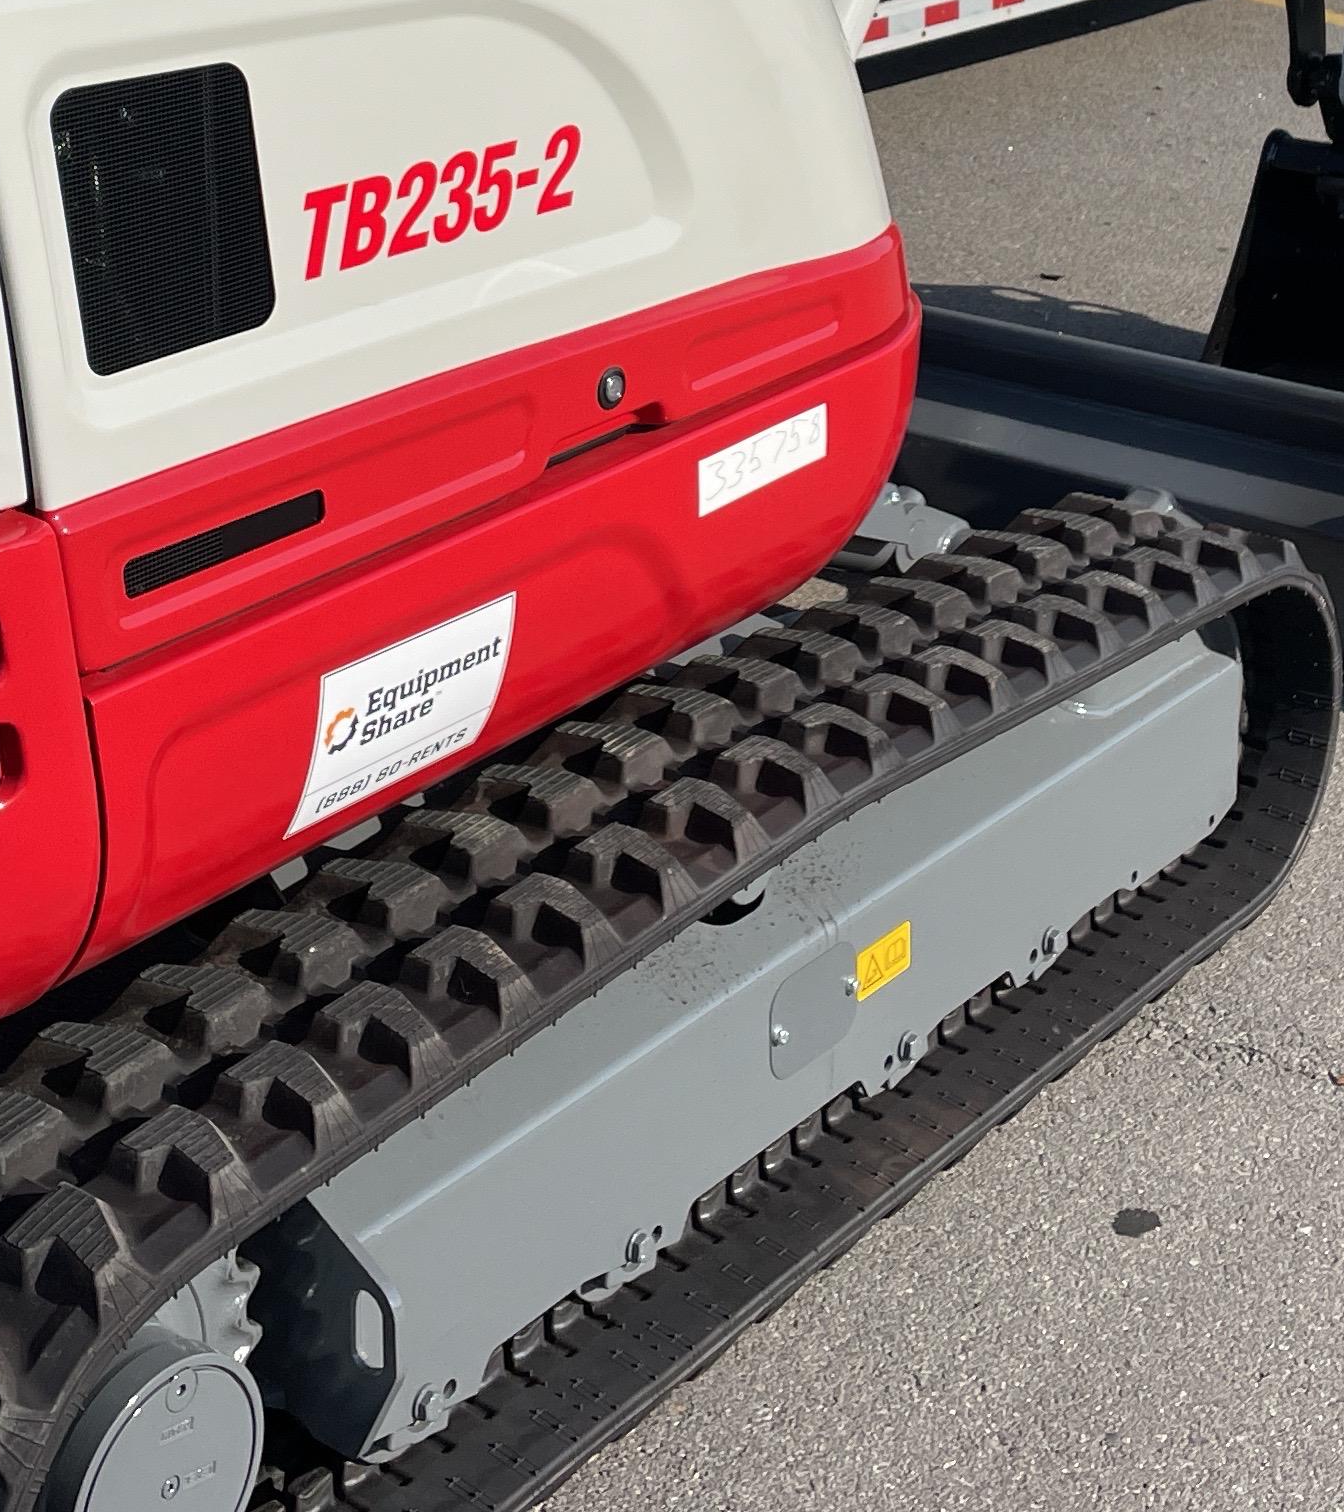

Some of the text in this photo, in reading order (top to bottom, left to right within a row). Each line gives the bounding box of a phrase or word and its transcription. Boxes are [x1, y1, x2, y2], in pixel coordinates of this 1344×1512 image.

[302, 124, 581, 281] TB235-2
[365, 636, 501, 717] Equipment
[359, 697, 434, 745] Share
